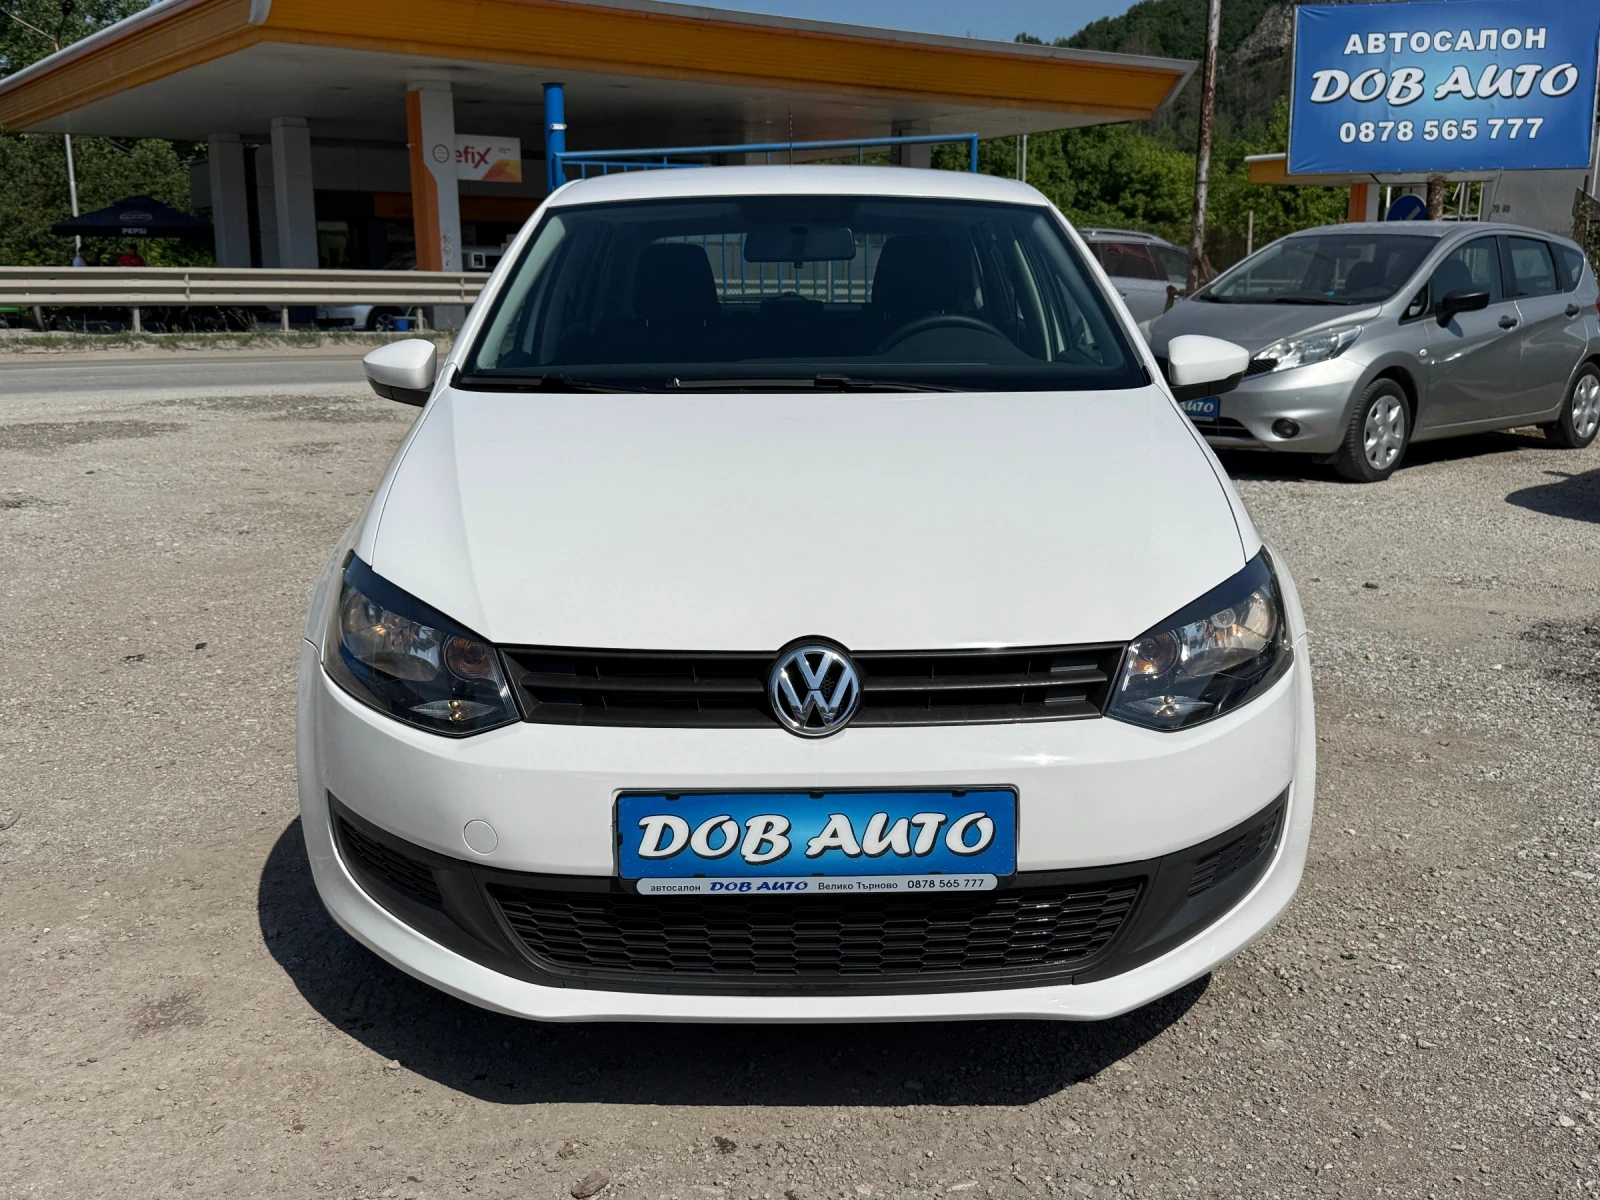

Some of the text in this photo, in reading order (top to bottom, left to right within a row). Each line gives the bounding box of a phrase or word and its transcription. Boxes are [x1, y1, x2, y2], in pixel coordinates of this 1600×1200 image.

[1343, 27, 1547, 55] АВТОСАЛОН
[1310, 62, 1579, 106] DOB AUTO
[1339, 117, 1544, 143] 0878 565 777
[637, 812, 996, 865] DOB AUTO
[650, 878, 984, 893] автосалон DOB AUTO Велико Търново 0878 565 777
